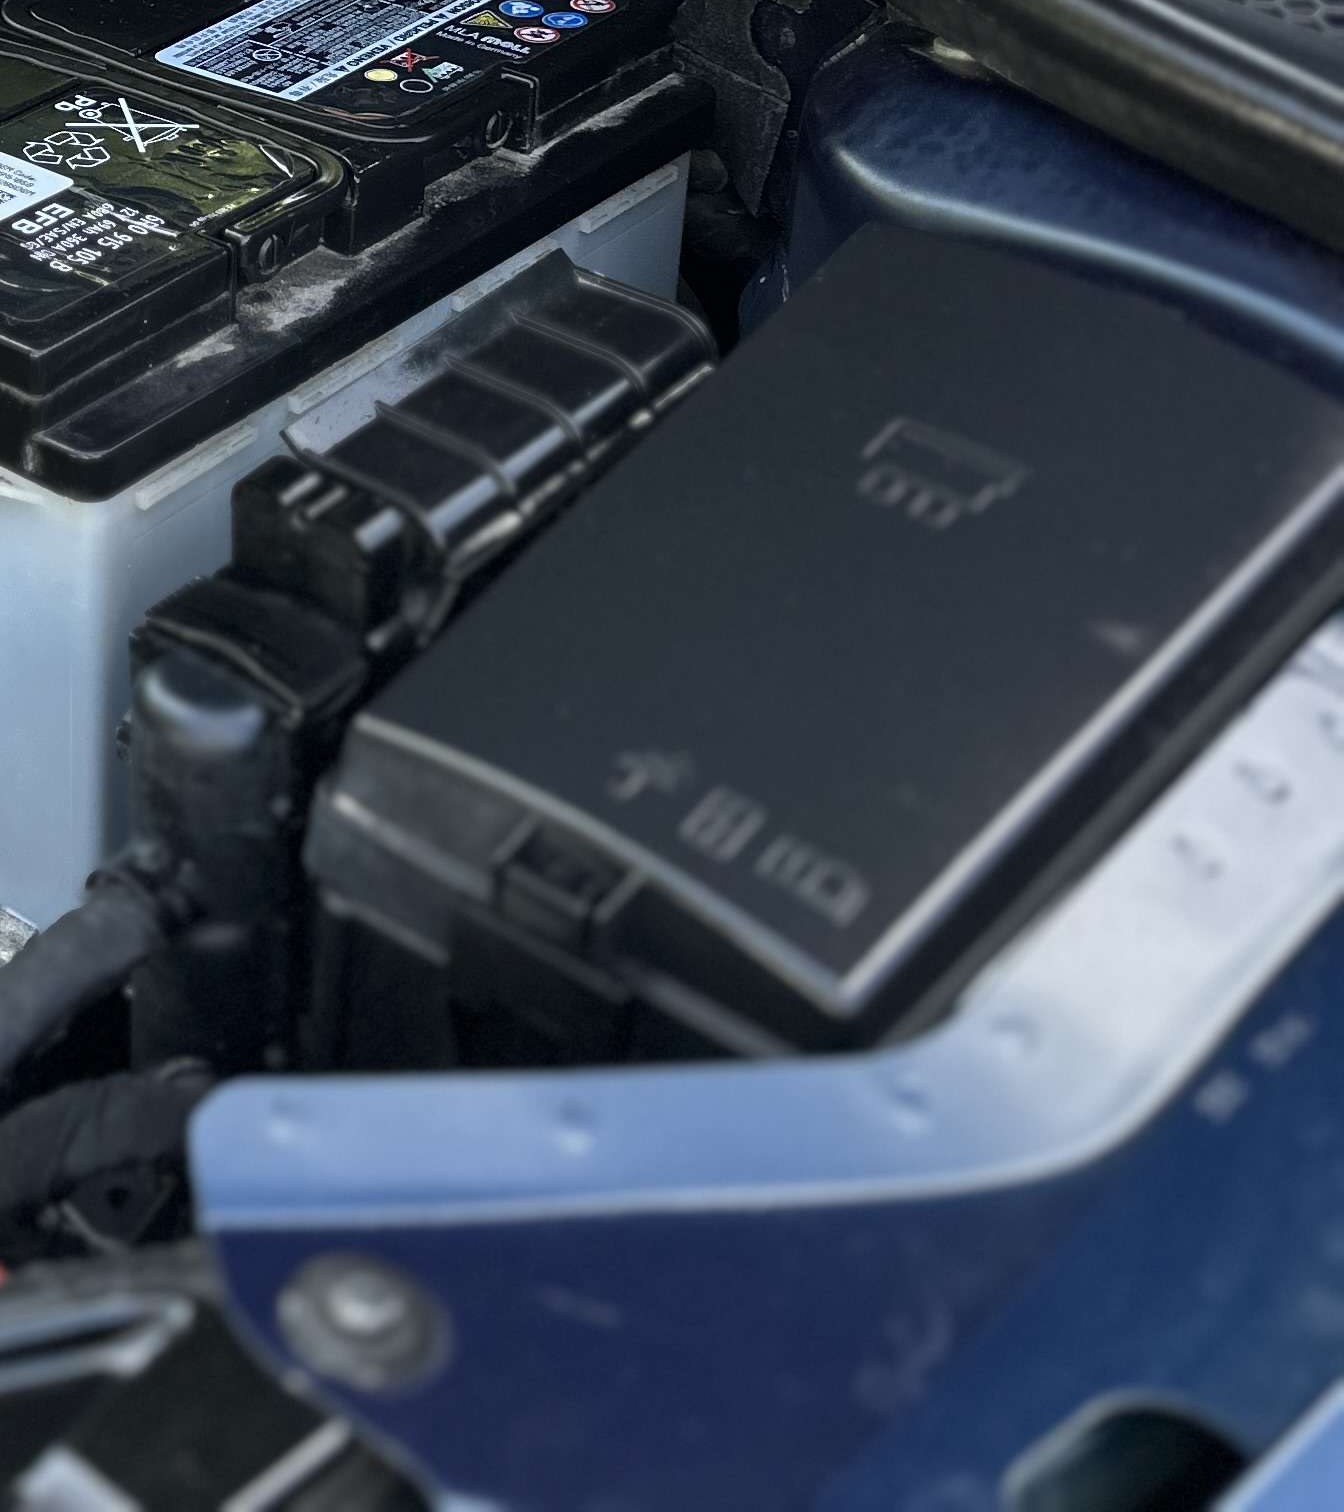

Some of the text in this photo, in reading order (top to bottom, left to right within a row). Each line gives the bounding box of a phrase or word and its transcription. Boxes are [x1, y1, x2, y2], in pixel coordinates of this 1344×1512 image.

[444, 25, 479, 40] MLA
[54, 94, 98, 111] Pb
[12, 202, 75, 235] EFB
[82, 219, 117, 235] 69Ah
[97, 231, 134, 250] 915
[67, 247, 102, 265] 105
[49, 260, 74, 273] B
